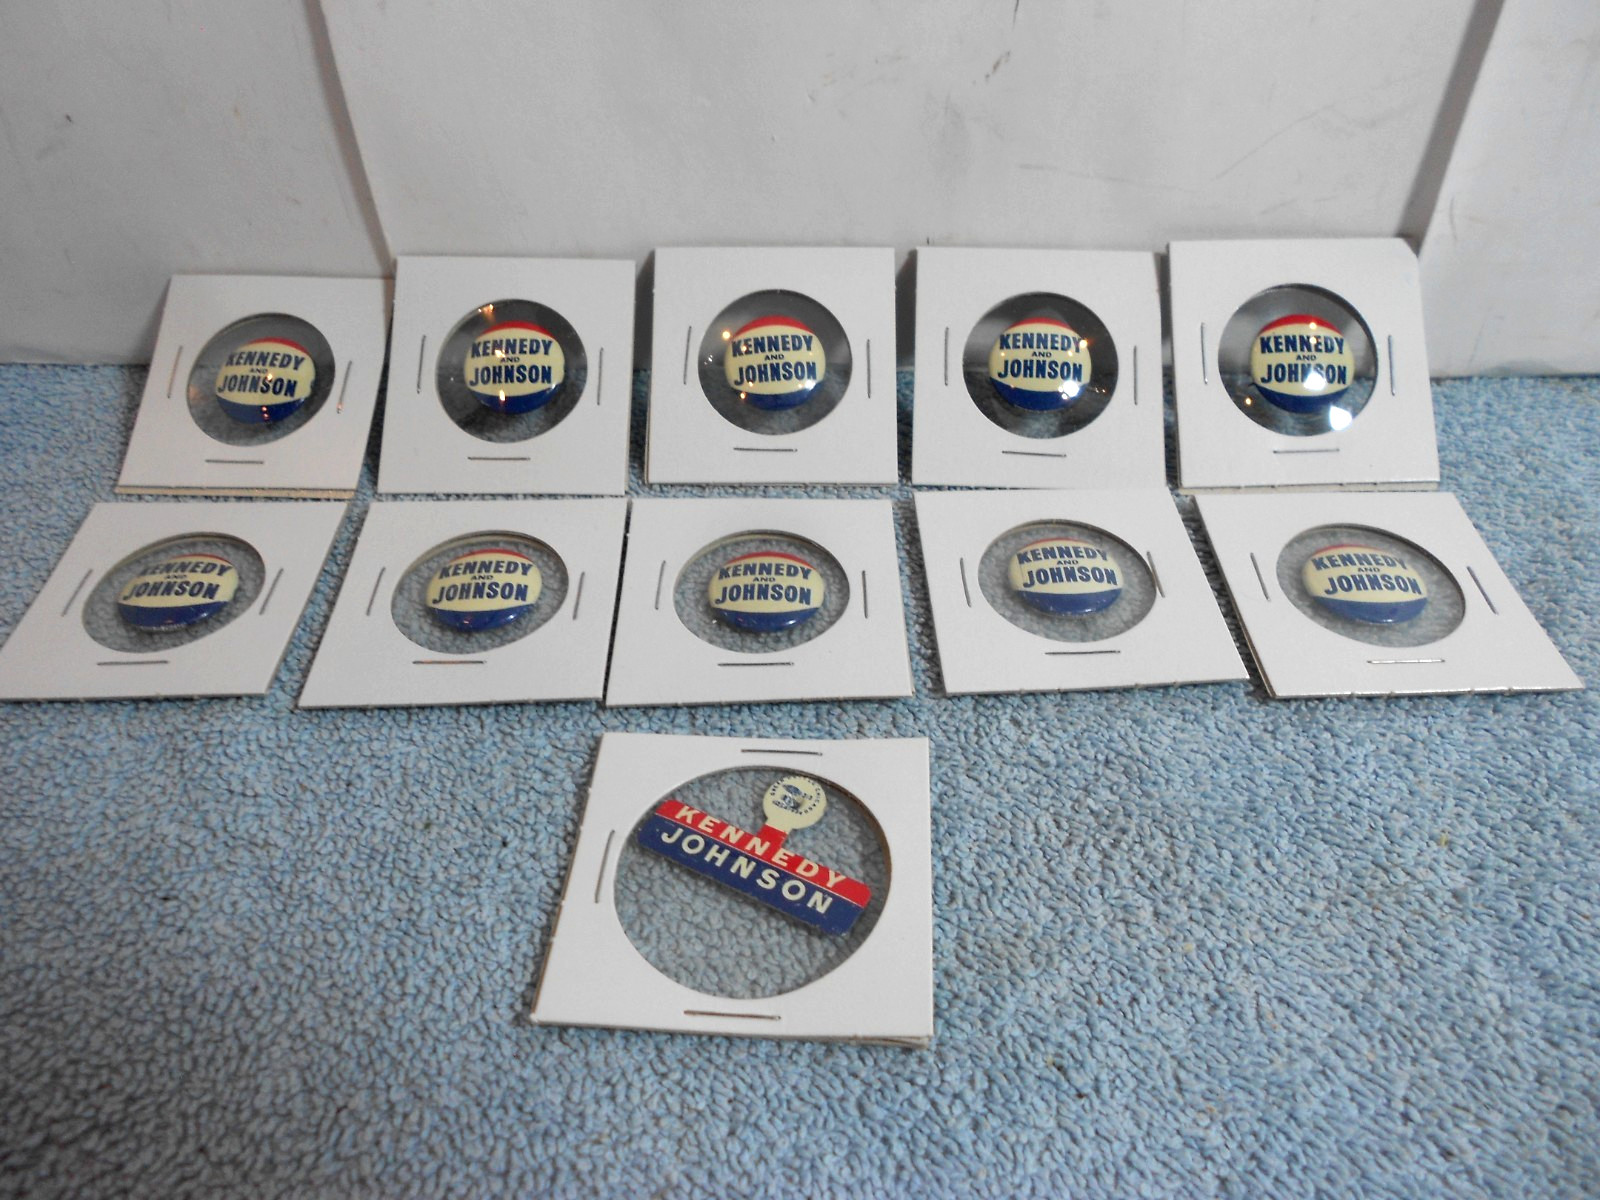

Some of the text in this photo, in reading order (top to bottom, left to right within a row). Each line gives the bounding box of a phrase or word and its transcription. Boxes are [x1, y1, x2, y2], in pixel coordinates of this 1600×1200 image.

[471, 338, 553, 358] KENNEDY
[732, 334, 813, 357] KENNEDY
[1000, 332, 1081, 353] KENNEDY
[1260, 334, 1345, 354] KENNEDY
[225, 351, 305, 371] KENNEDY
[764, 353, 785, 361] AND
[469, 364, 552, 387] JOHNSON
[734, 361, 817, 386] JOHNSON
[997, 359, 1083, 382] JOHNSON
[217, 374, 298, 398] JOHNSON
[1016, 545, 1108, 565] KENNEDY
[1311, 553, 1408, 571] KENNEDY
[439, 560, 533, 580] KENNEDY
[718, 562, 812, 580] KENNEDY
[1022, 566, 1118, 588] JOHNSON
[122, 580, 220, 601] JOHNSON
[431, 581, 529, 605] JOHNSON
[714, 583, 812, 606] JOHNSON
[1324, 573, 1422, 595] JOHNSON
[675, 805, 847, 889] KENNEDY
[660, 827, 833, 914] JOHNSON
